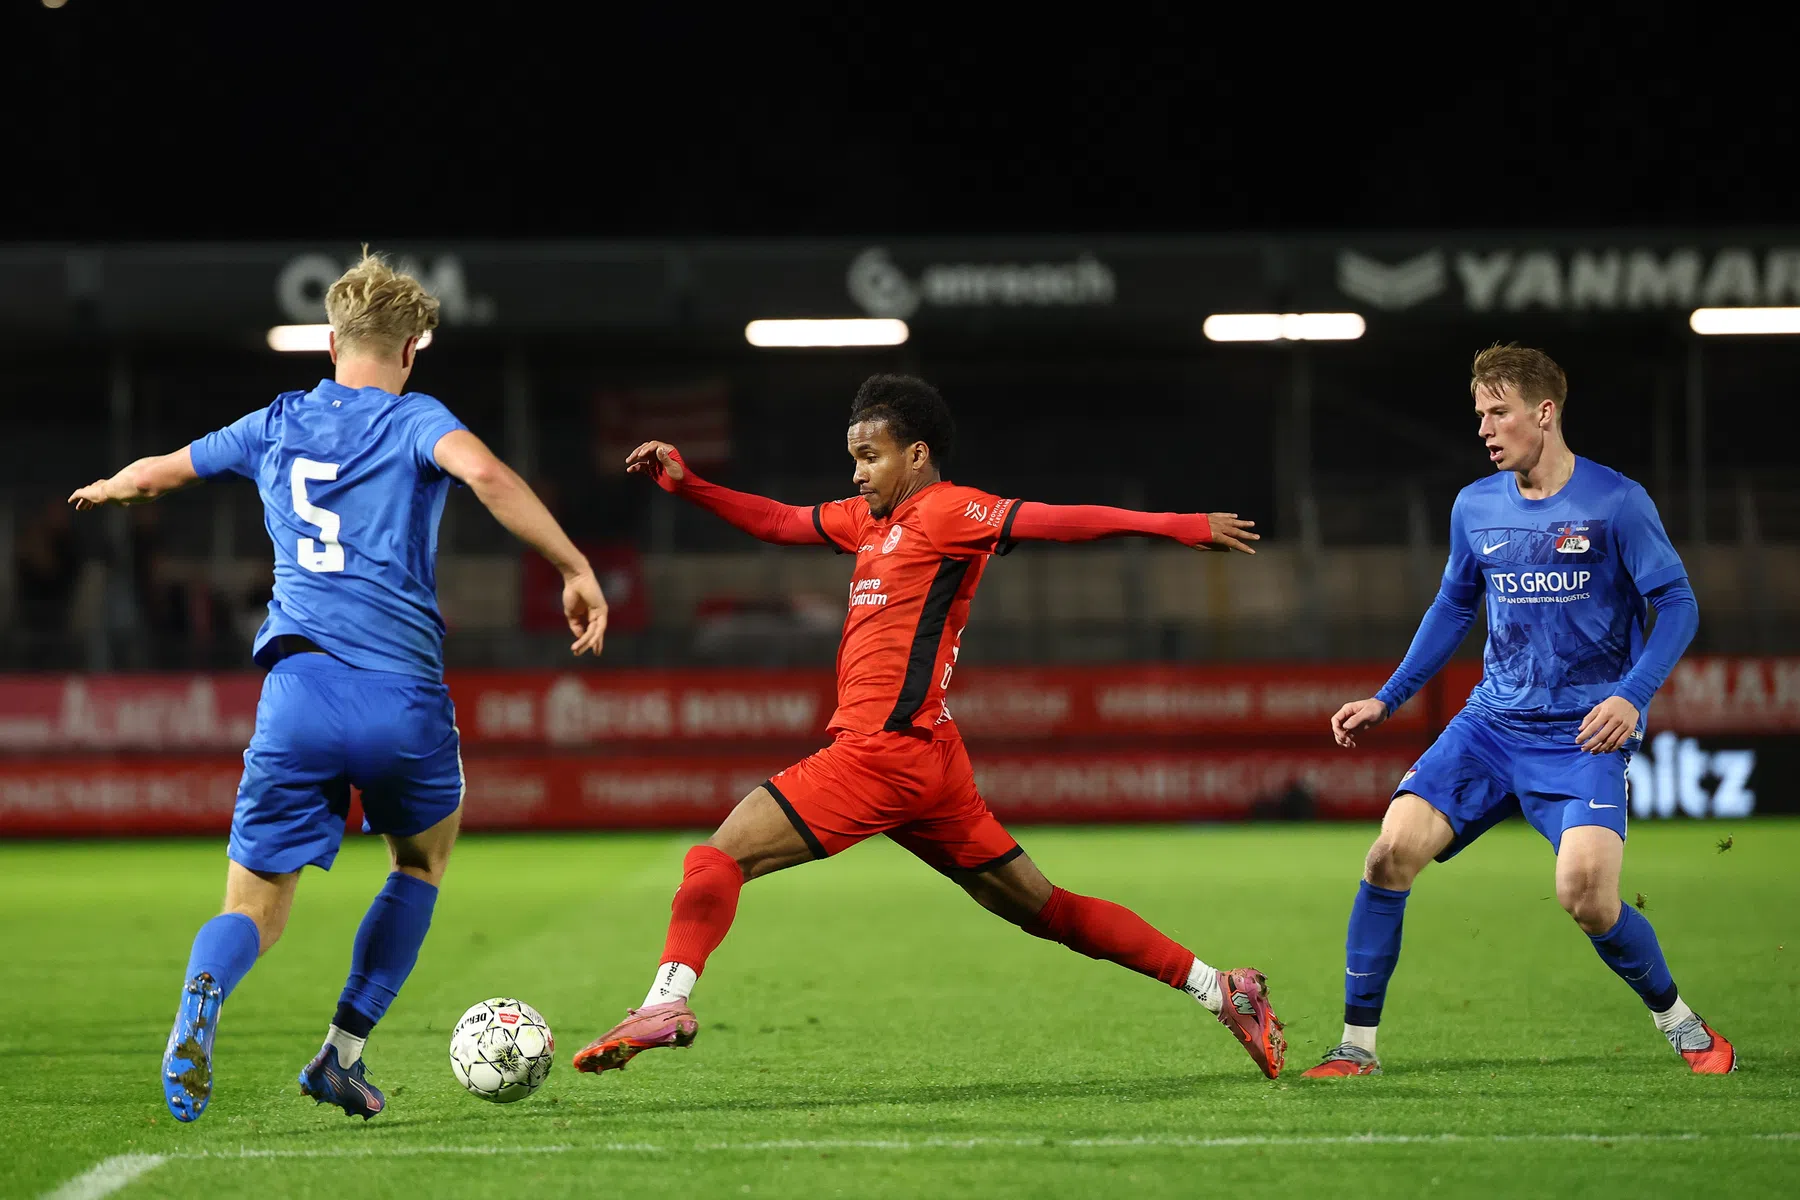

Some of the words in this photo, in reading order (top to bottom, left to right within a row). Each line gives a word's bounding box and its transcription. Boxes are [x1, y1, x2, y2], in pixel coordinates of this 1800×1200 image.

[291, 457, 345, 573] 5
[1520, 571, 1591, 593] GROUP
[664, 961, 680, 987] CRAFT
